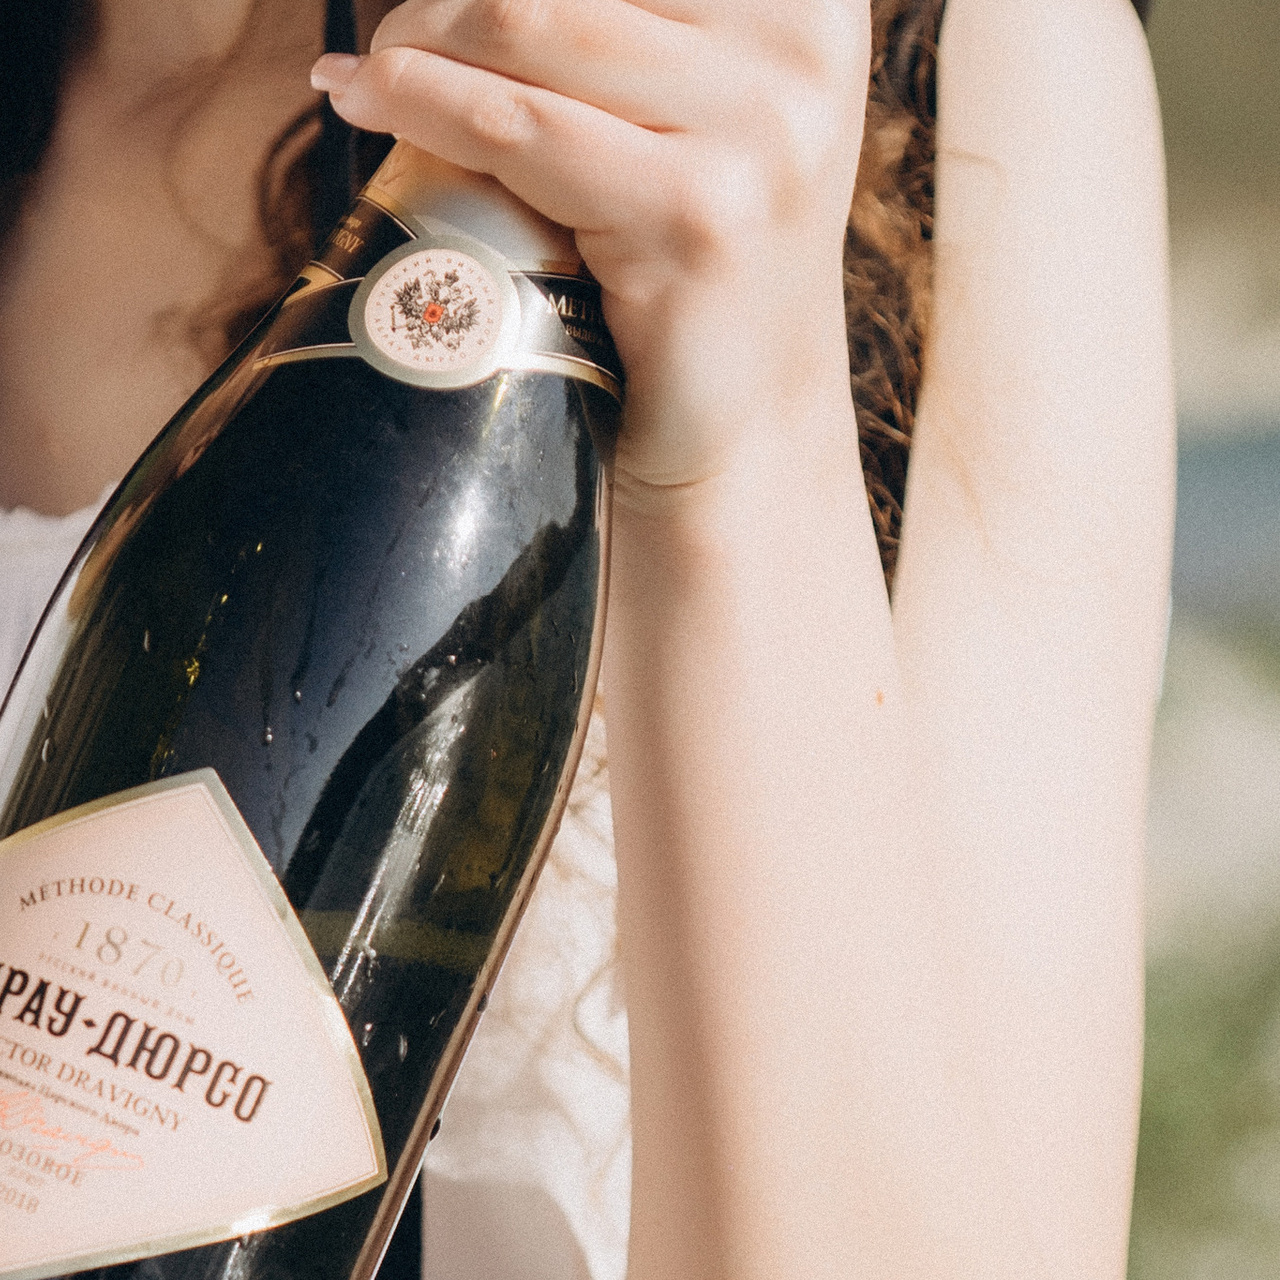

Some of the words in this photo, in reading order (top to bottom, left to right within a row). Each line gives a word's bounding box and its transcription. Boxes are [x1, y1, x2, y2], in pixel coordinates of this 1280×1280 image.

[74, 922, 185, 987] 1870
[147, 892, 254, 1004] CLASSIQUE
[56, 1062, 186, 1131] DRAVIGNY
